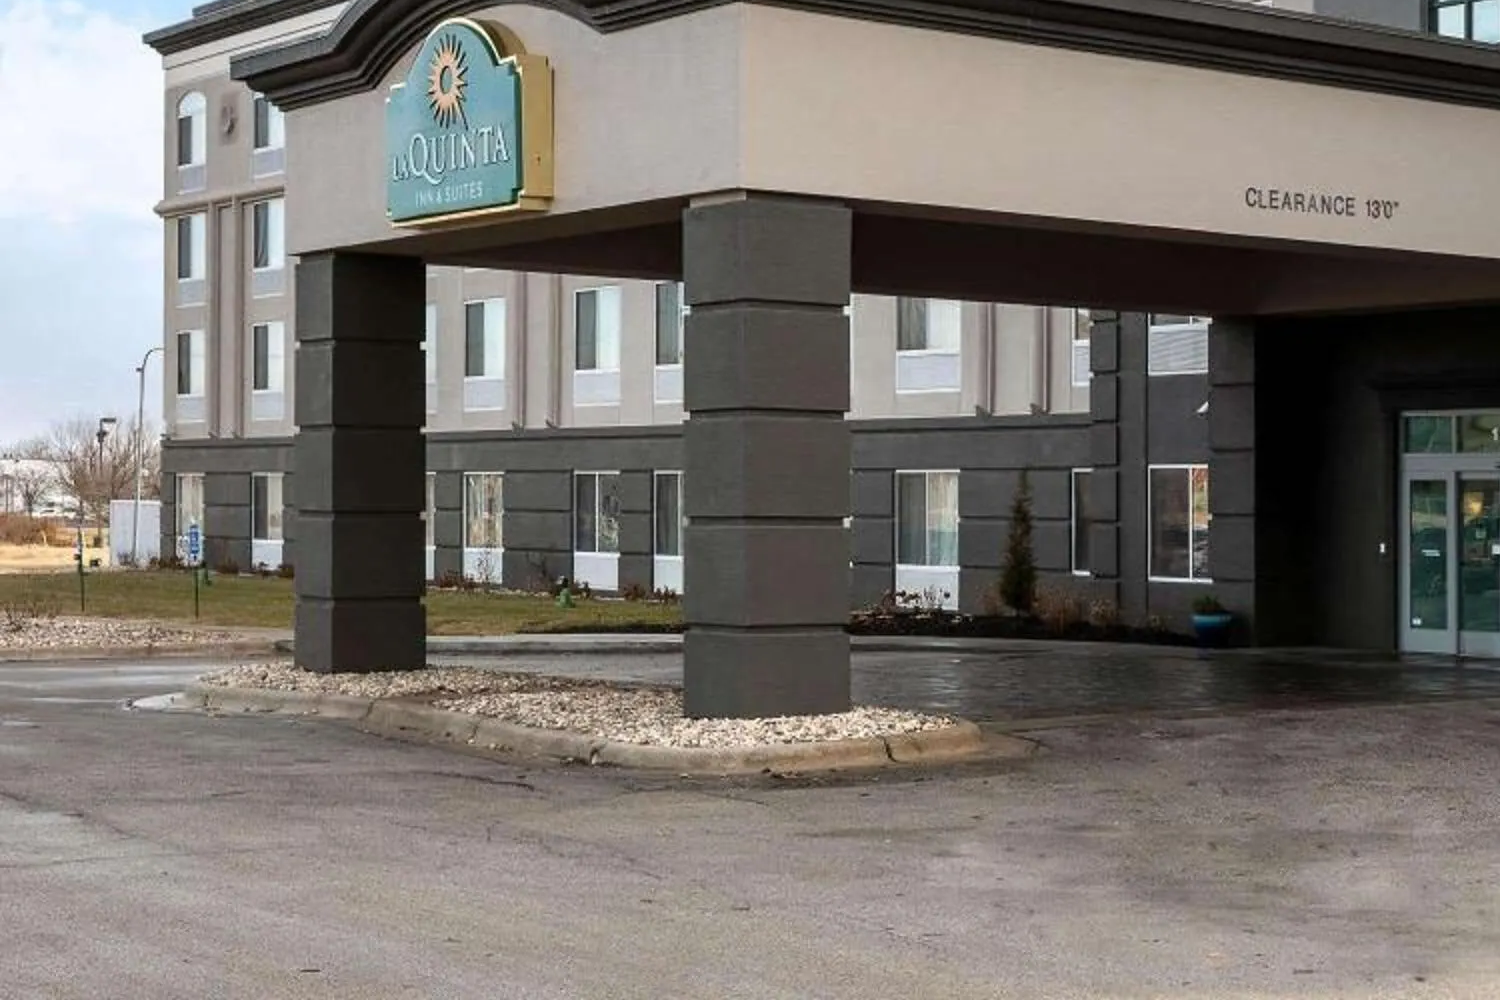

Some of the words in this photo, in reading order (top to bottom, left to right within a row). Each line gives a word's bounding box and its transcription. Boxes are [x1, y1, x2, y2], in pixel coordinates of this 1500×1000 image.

[409, 124, 511, 186] QUINTA
[444, 181, 484, 201] SUITES
[1245, 187, 1356, 216] CLEARANCE
